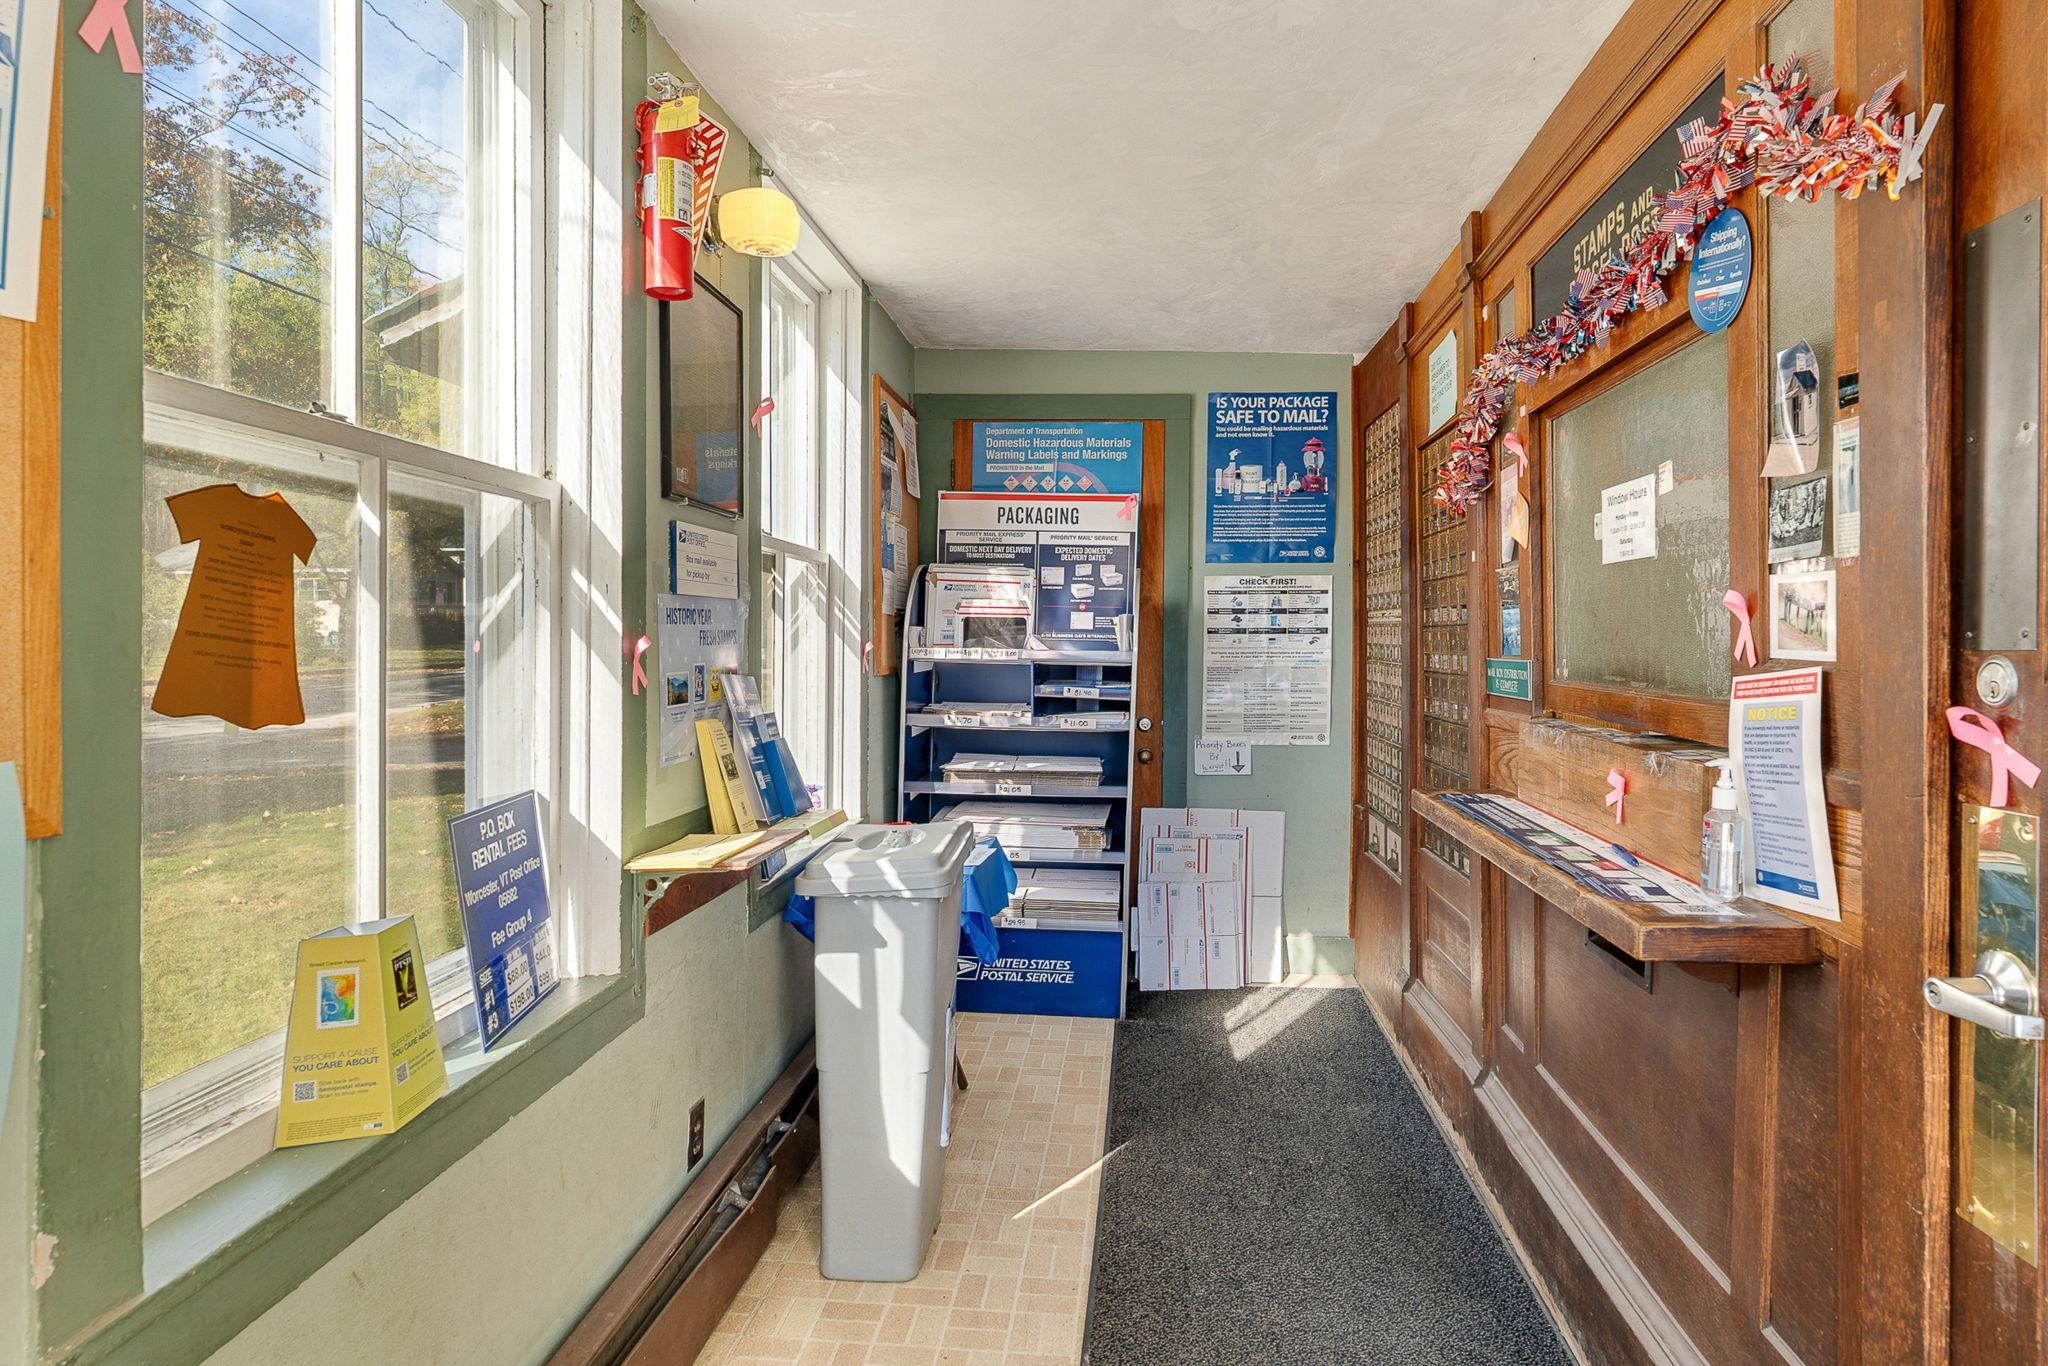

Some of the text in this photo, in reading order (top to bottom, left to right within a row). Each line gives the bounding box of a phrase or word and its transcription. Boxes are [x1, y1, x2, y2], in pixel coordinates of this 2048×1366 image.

[1574, 186, 1654, 274] STAMPS AND
[1710, 228, 1737, 242] Shipping
[1699, 235, 1746, 259] Internationally?
[1216, 396, 1328, 408] IS YOUR PACKAGE
[1216, 409, 1329, 424] SAFE TO MAIL?
[986, 427, 1025, 436] Department
[1035, 428, 1083, 436] Transportation
[986, 438, 1131, 448] Domestic Hazardous Materials
[986, 450, 1127, 462] Warning Labels and Markings
[1607, 487, 1648, 507] Window Hours
[997, 507, 1079, 524] PACKAGING
[694, 556, 702, 564] mail
[702, 557, 717, 567] available
[692, 570, 704, 580] pickup
[666, 608, 696, 625] HISTORIC
[699, 629, 716, 646] FRESH
[1748, 705, 1797, 721] NOTICE
[1196, 740, 1223, 752] Priority
[480, 810, 516, 840] P.O. BOX
[471, 829, 528, 870] RENTAL FEES
[464, 857, 541, 908] Worcester, VT Post Office
[498, 886, 518, 909] 05682
[491, 929, 506, 949] Fee
[506, 917, 526, 938] Group
[526, 908, 532, 923] 4
[394, 956, 411, 971] PTSD
[536, 945, 551, 965] $44.0
[984, 958, 1071, 970] NITED STATES
[479, 968, 493, 985] SIZE
[980, 971, 1023, 981] POSTAL
[485, 989, 495, 1011] #1
[510, 985, 534, 1014] $198.00
[488, 1012, 498, 1034] #3
[392, 1026, 434, 1057] YOU CARE ABOUT
[292, 1051, 338, 1064] SUPPORT
[347, 1047, 378, 1057] CAUSE
[292, 1056, 379, 1073] YOU CARE ABOUT
